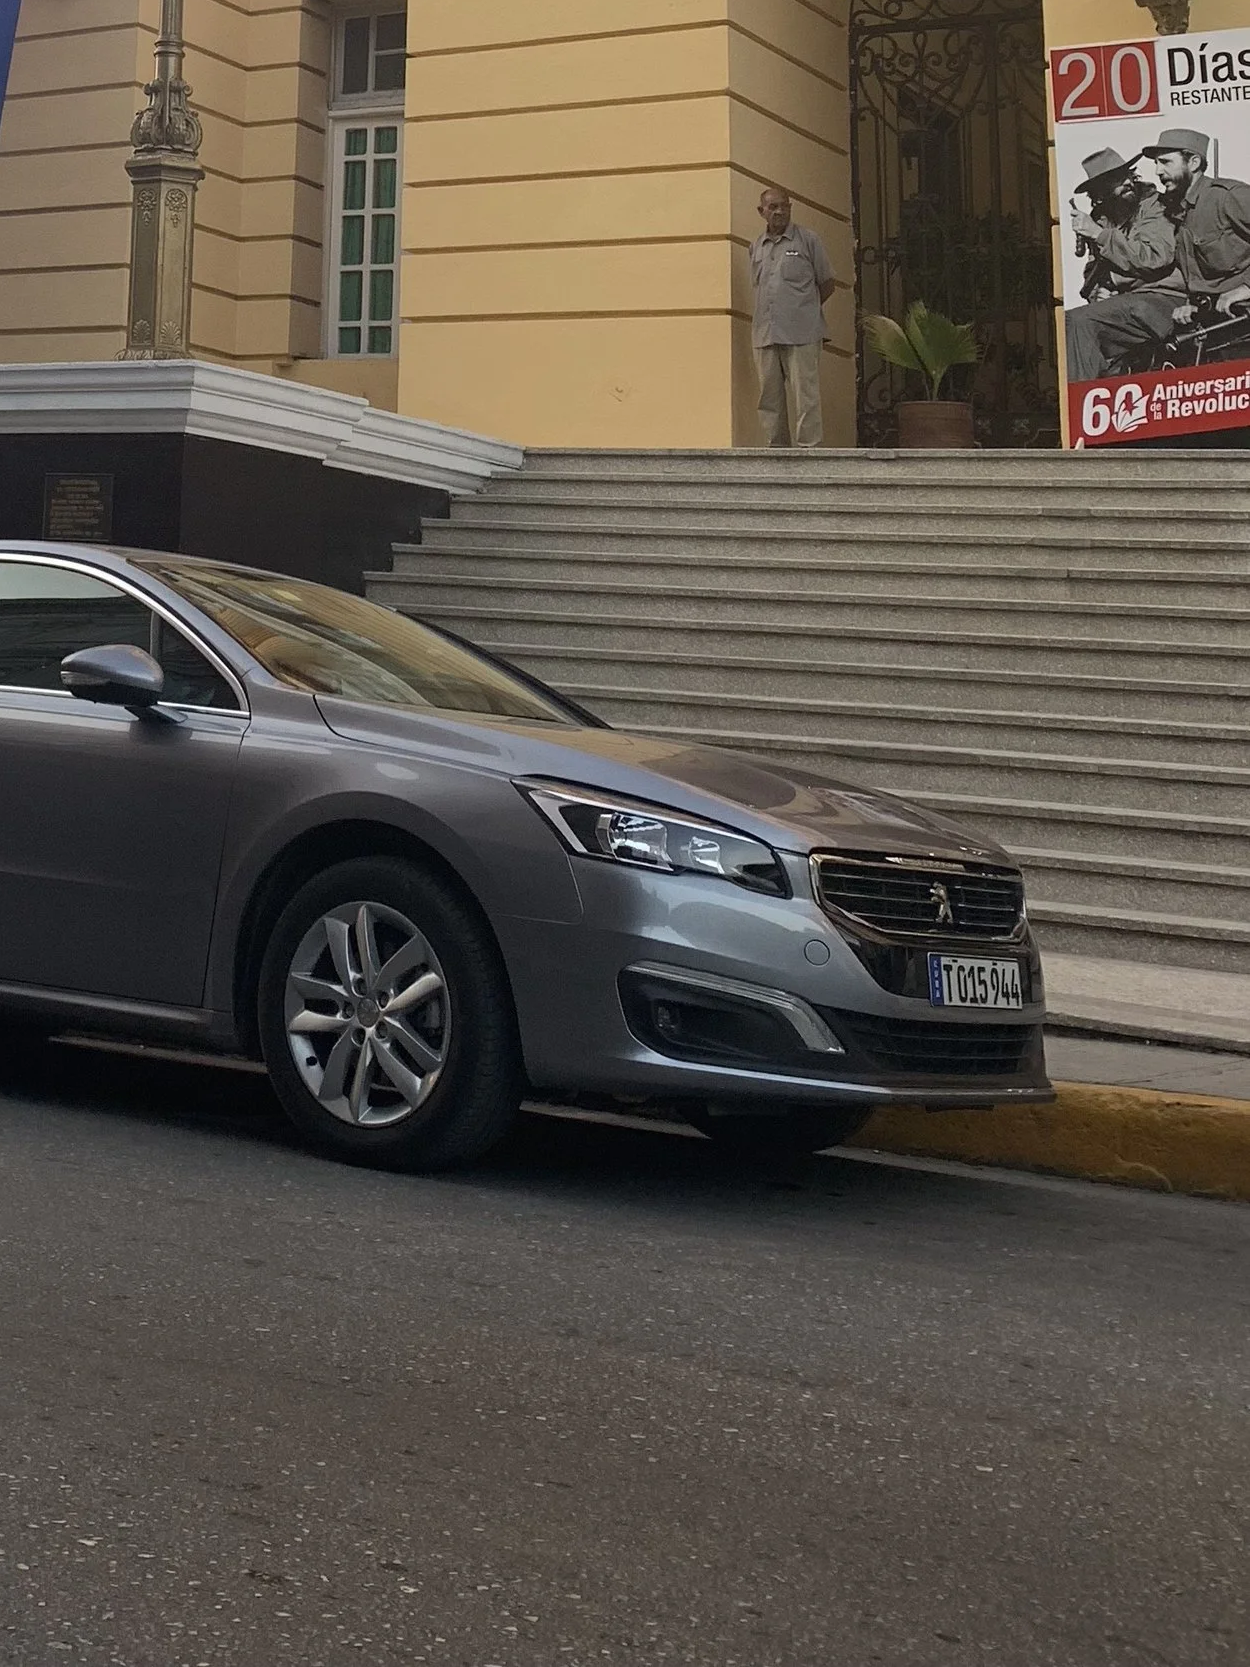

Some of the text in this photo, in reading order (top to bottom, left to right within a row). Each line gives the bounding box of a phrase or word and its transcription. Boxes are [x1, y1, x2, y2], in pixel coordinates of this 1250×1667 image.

[1058, 42, 1250, 117] 20 Días
[1170, 85, 1250, 107] RESTANTE
[1150, 403, 1163, 421] de la
